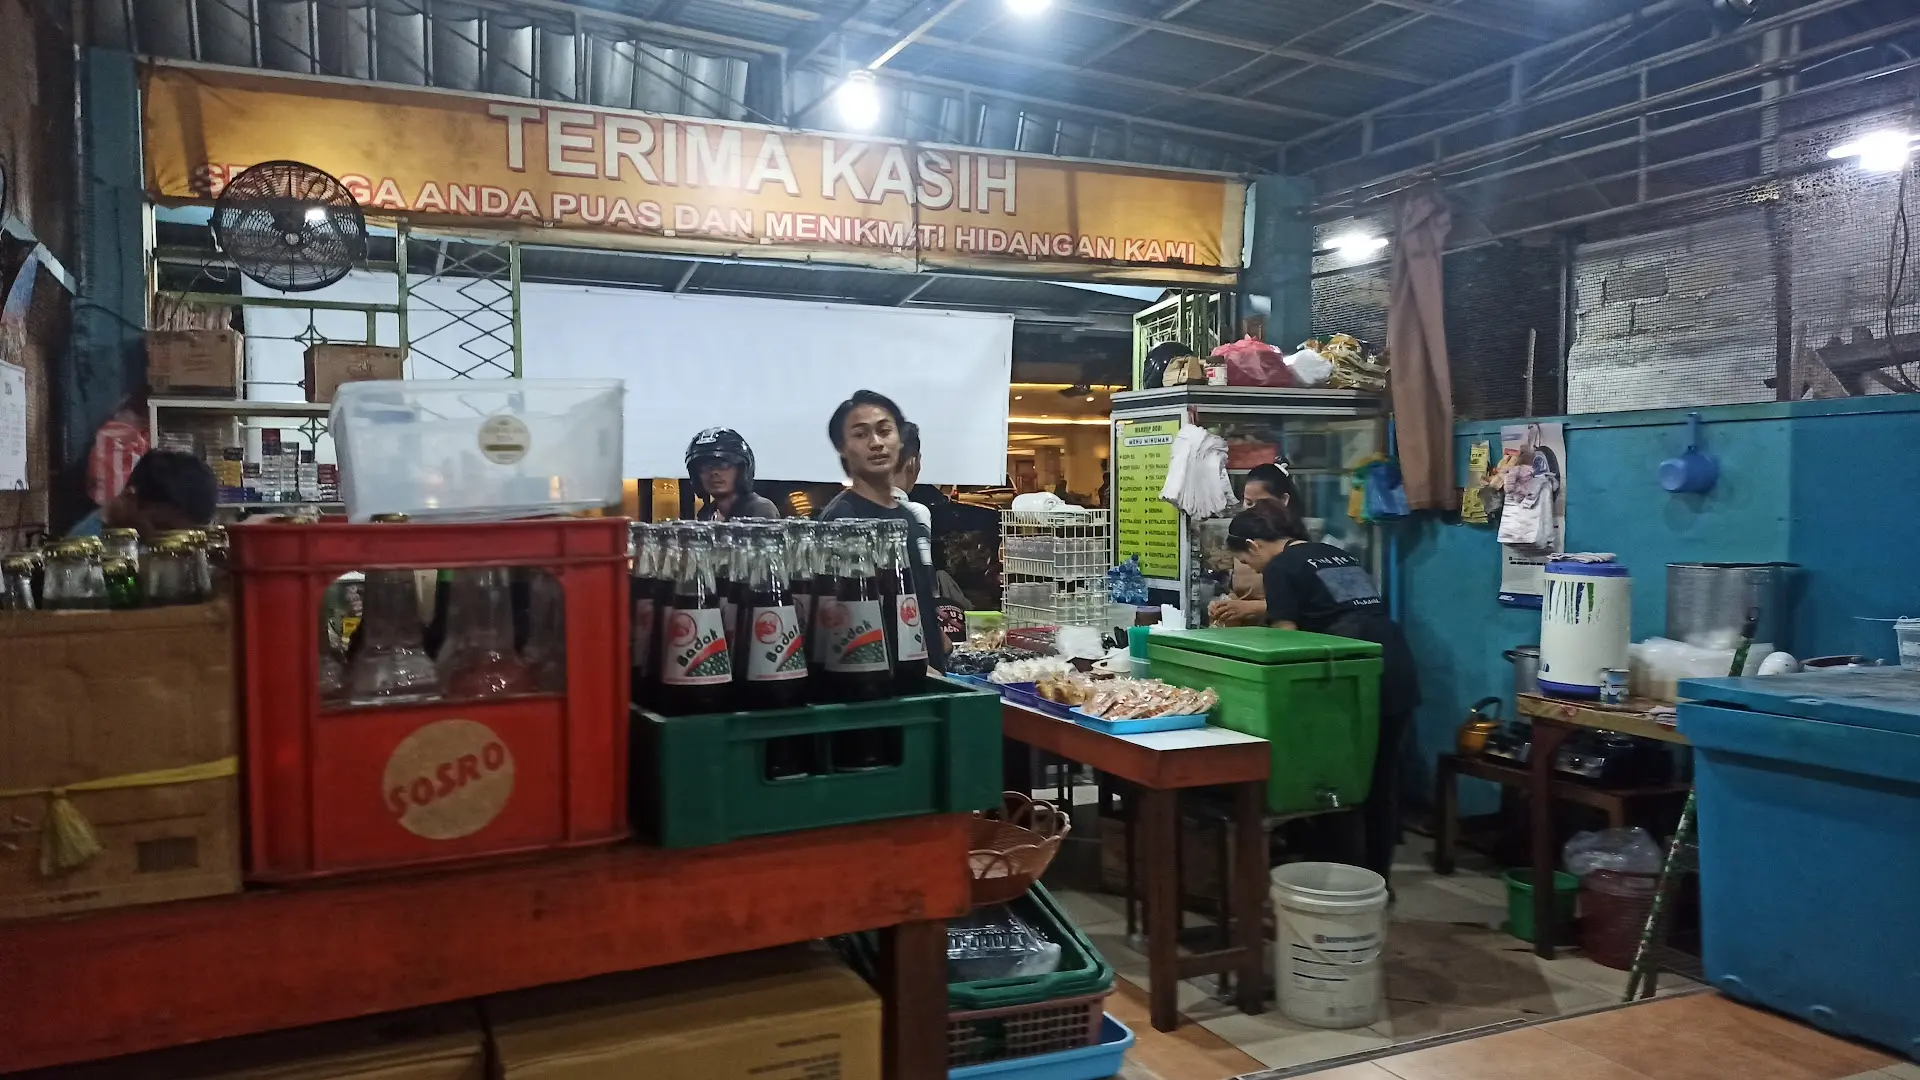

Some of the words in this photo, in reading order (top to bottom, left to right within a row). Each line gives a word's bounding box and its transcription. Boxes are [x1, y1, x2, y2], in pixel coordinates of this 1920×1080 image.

[488, 103, 800, 197] TERIMA
[821, 138, 1017, 215] KASIH
[415, 181, 543, 220] ANDA
[551, 193, 664, 230] PUAS
[674, 203, 754, 237] DAN
[764, 211, 945, 249] MENIKMATI
[954, 225, 1116, 260] HIDANGAN
[1123, 238, 1196, 264] KAMI
[677, 628, 719, 667] Badak
[389, 742, 504, 819] SOSRO
